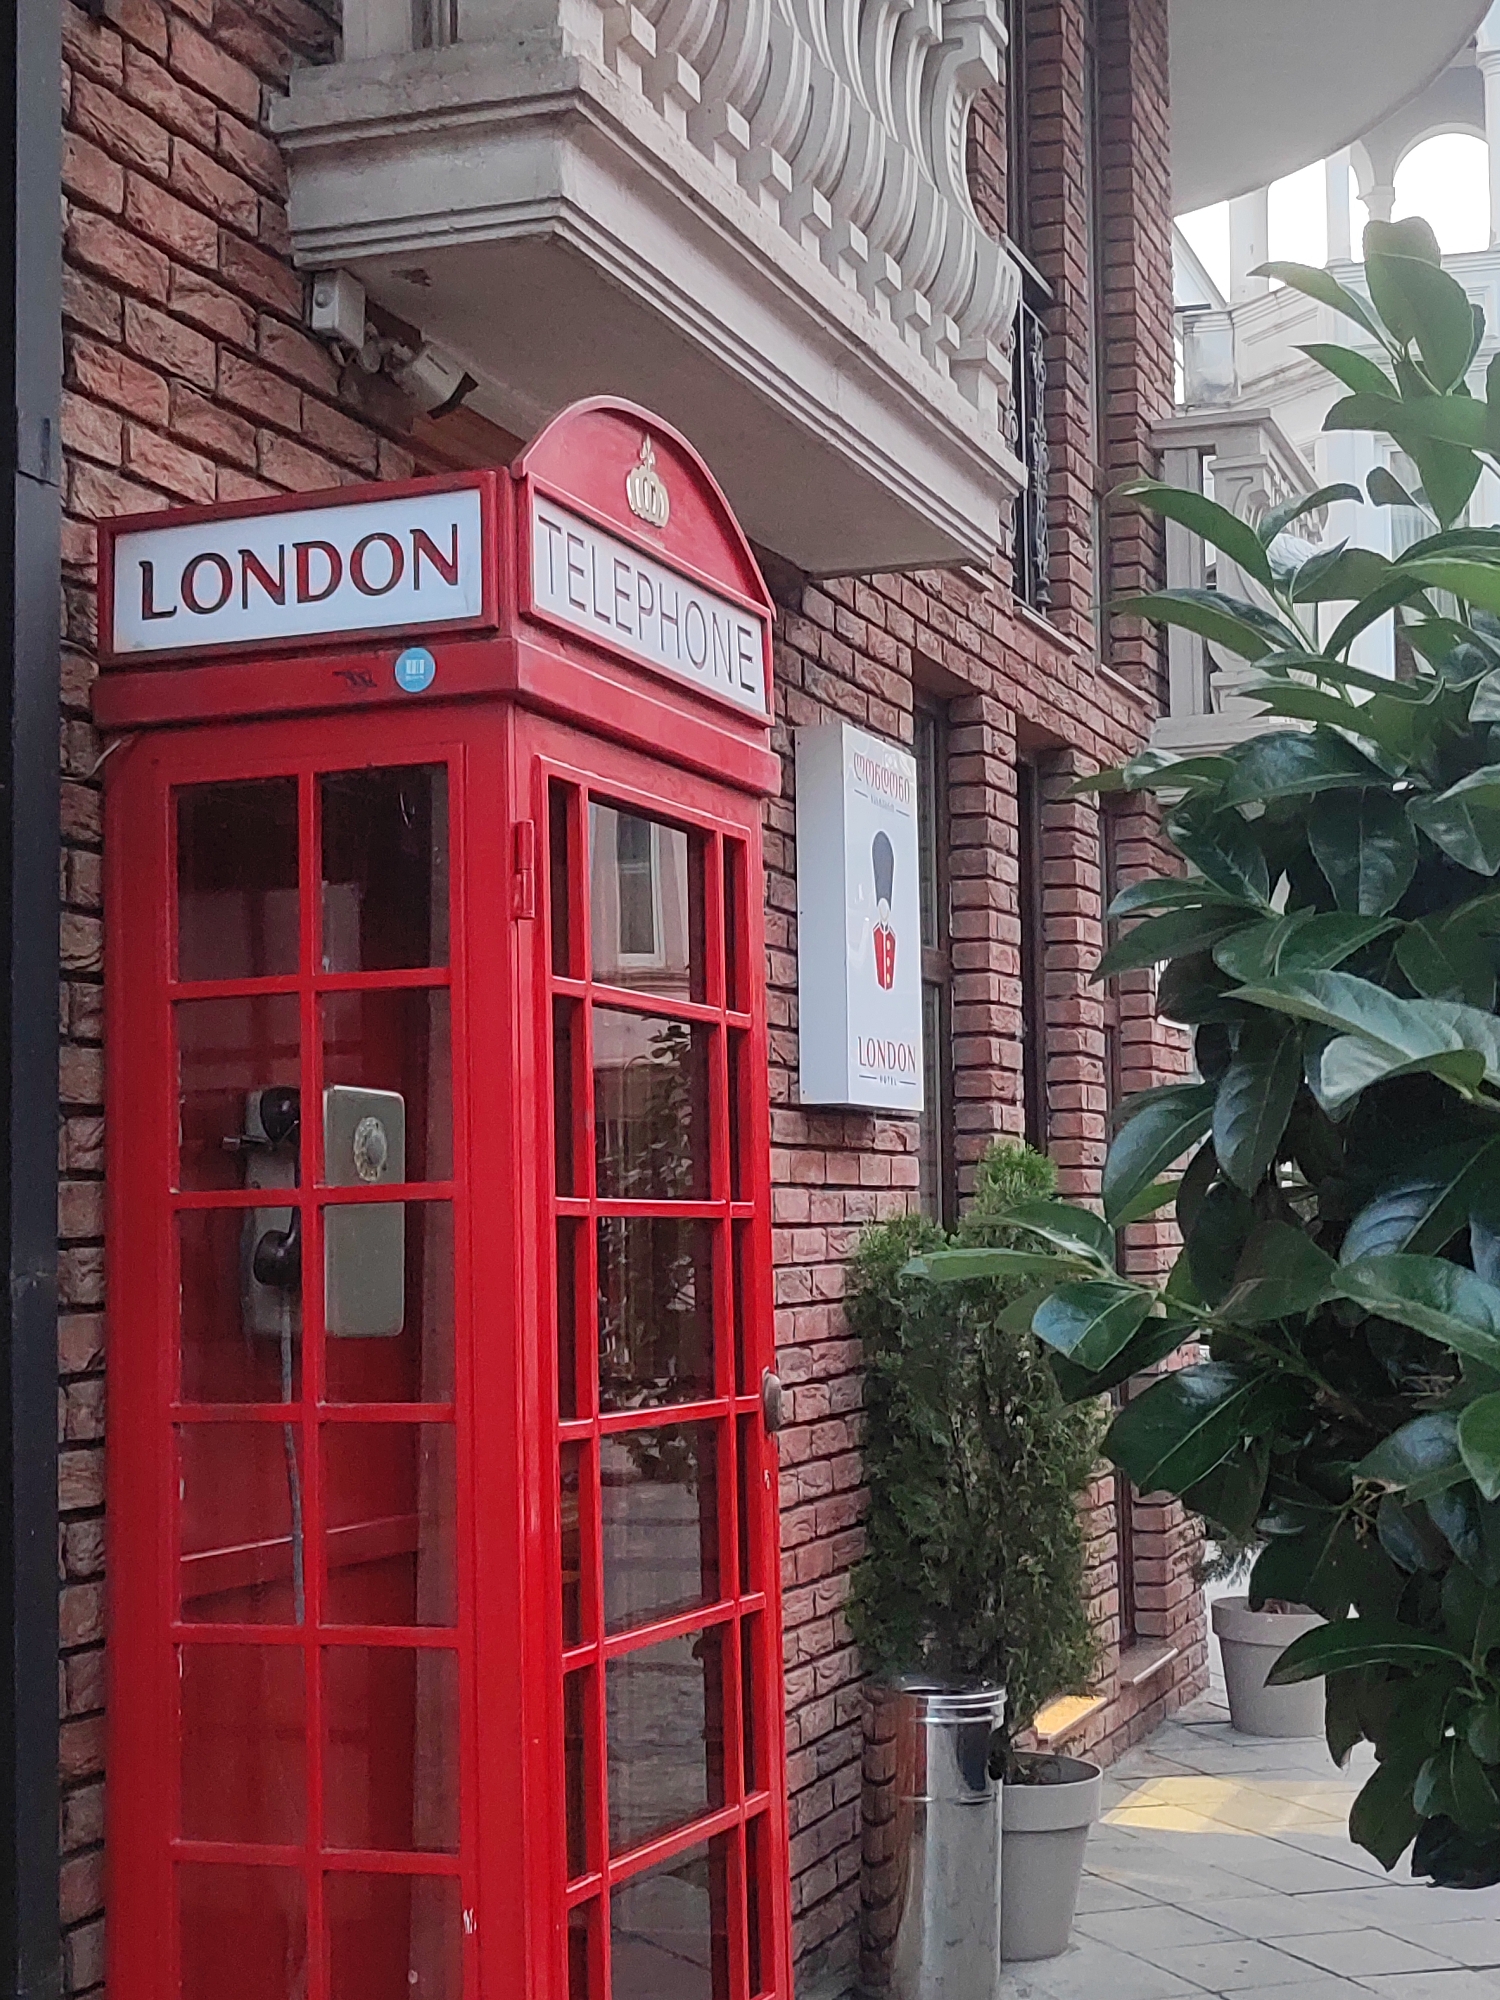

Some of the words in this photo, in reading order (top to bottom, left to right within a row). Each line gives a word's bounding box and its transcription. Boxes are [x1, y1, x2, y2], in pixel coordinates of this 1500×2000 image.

[138, 522, 459, 621] LONDON
[537, 513, 756, 694] TELEPHONE
[853, 752, 910, 804] ლონდონი
[857, 1036, 916, 1074] LONDON
